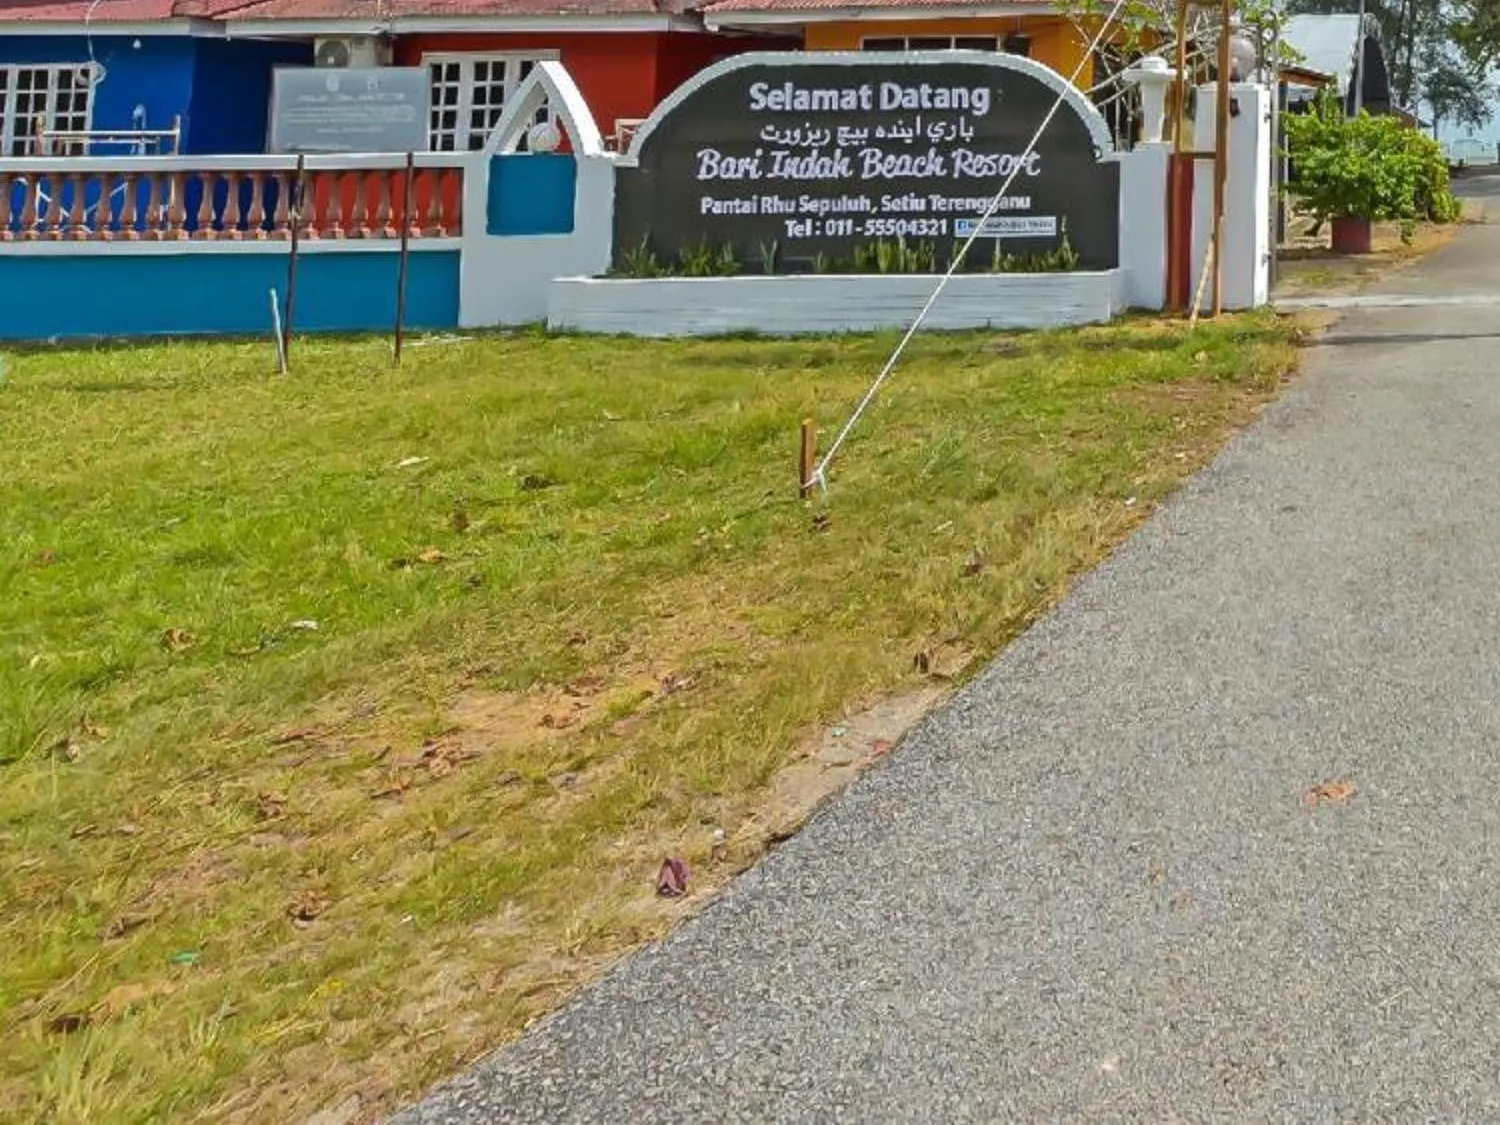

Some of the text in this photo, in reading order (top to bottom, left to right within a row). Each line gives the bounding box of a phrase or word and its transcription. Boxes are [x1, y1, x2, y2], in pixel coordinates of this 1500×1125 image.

[750, 82, 991, 116] Selamat Datang
[696, 146, 1042, 180] Bari Indah Beach Resort
[701, 192, 1032, 218] Pantai Rhu Sepuluh, Setiu Terengganu
